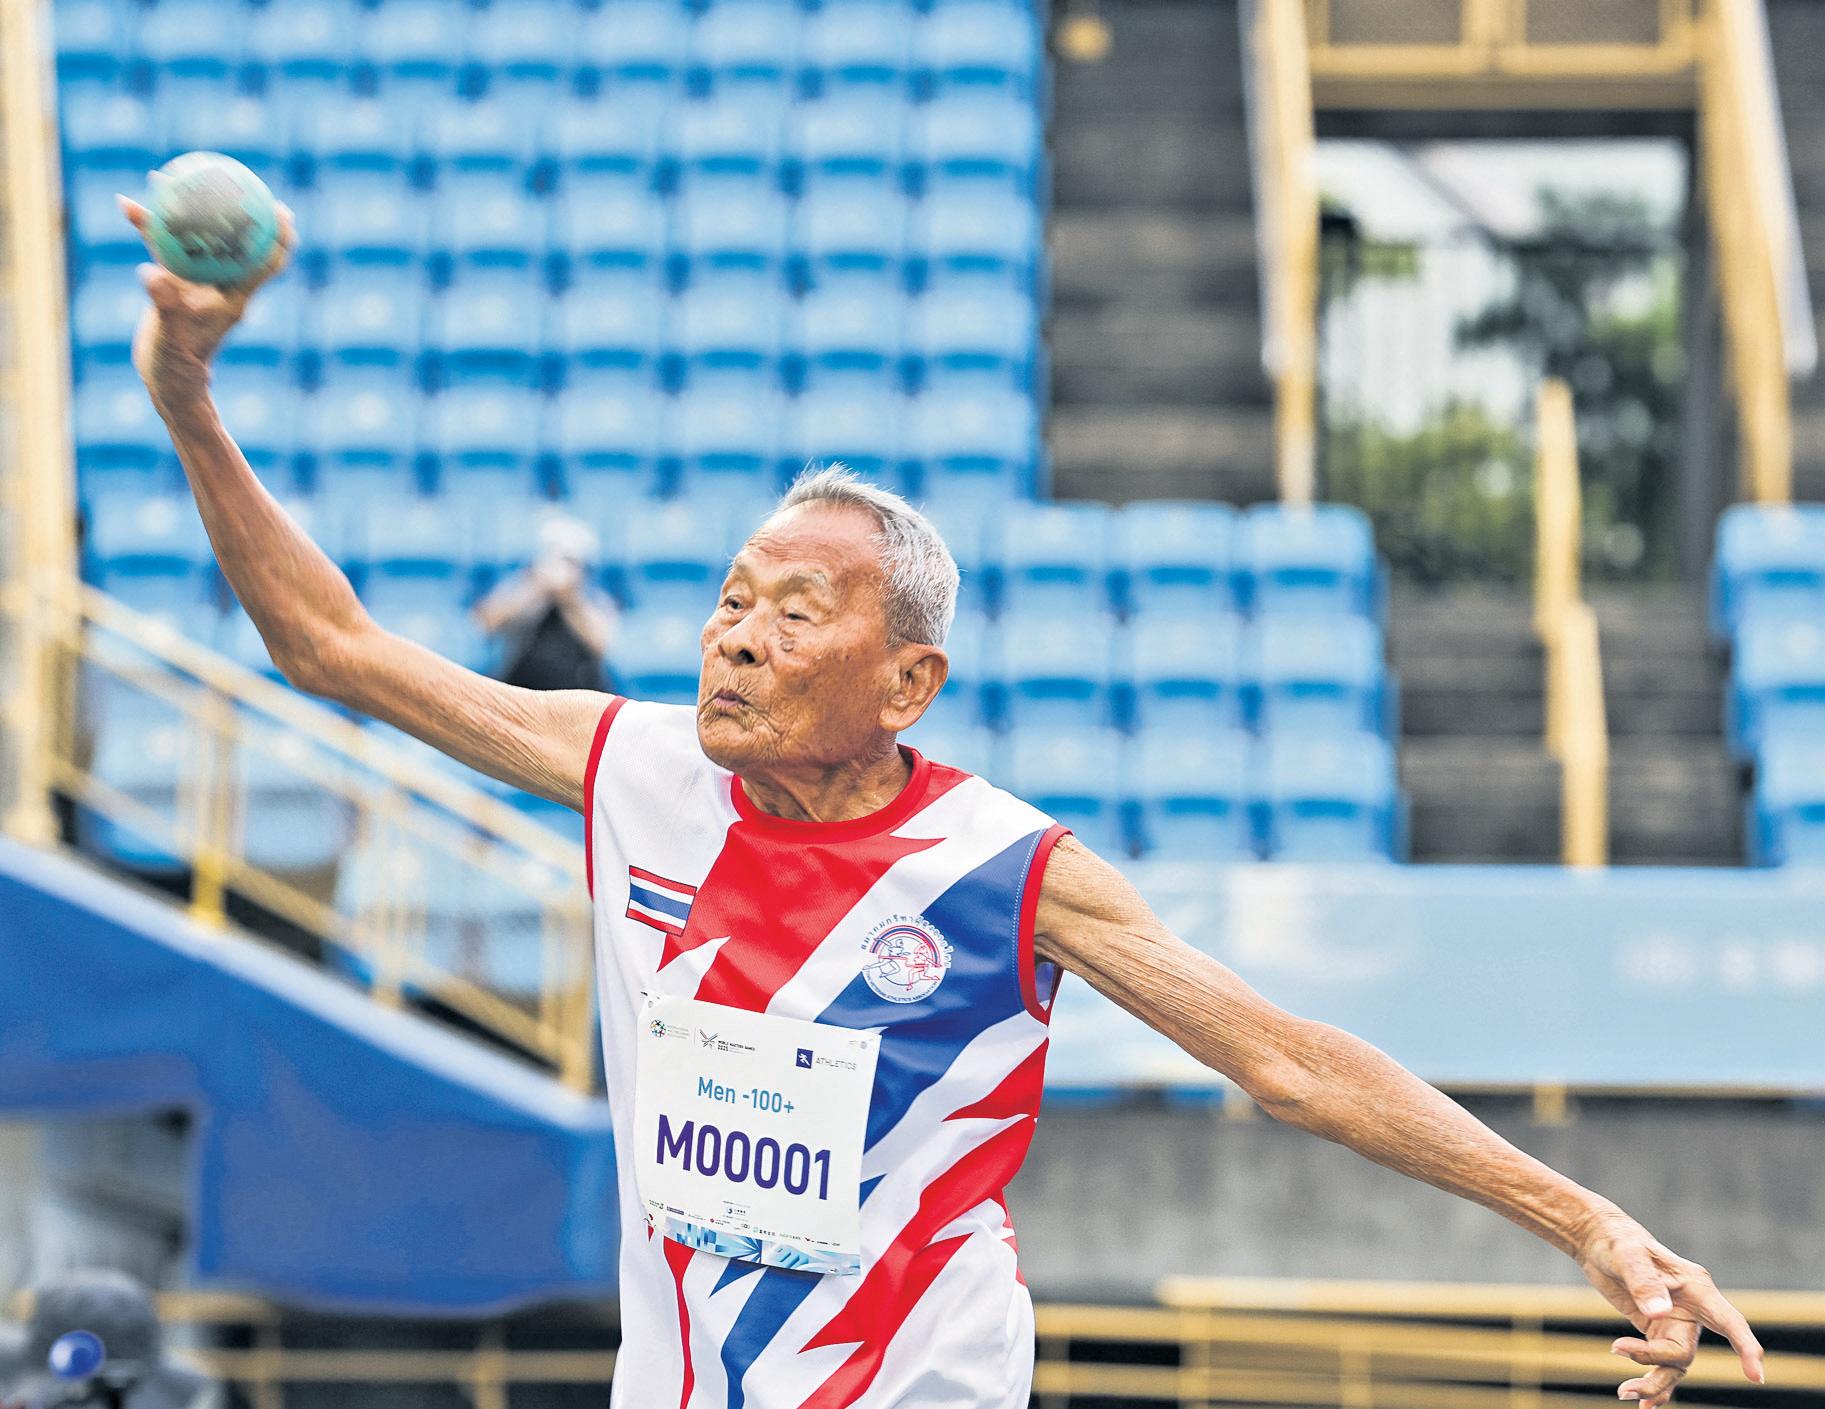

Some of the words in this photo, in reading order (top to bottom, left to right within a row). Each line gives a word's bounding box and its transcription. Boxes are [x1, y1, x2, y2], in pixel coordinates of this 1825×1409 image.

[815, 1057, 857, 1071] ATHLETICS
[698, 1076, 736, 1104] Men
[742, 1088, 795, 1114] -100+
[656, 1114, 831, 1200] M00001
